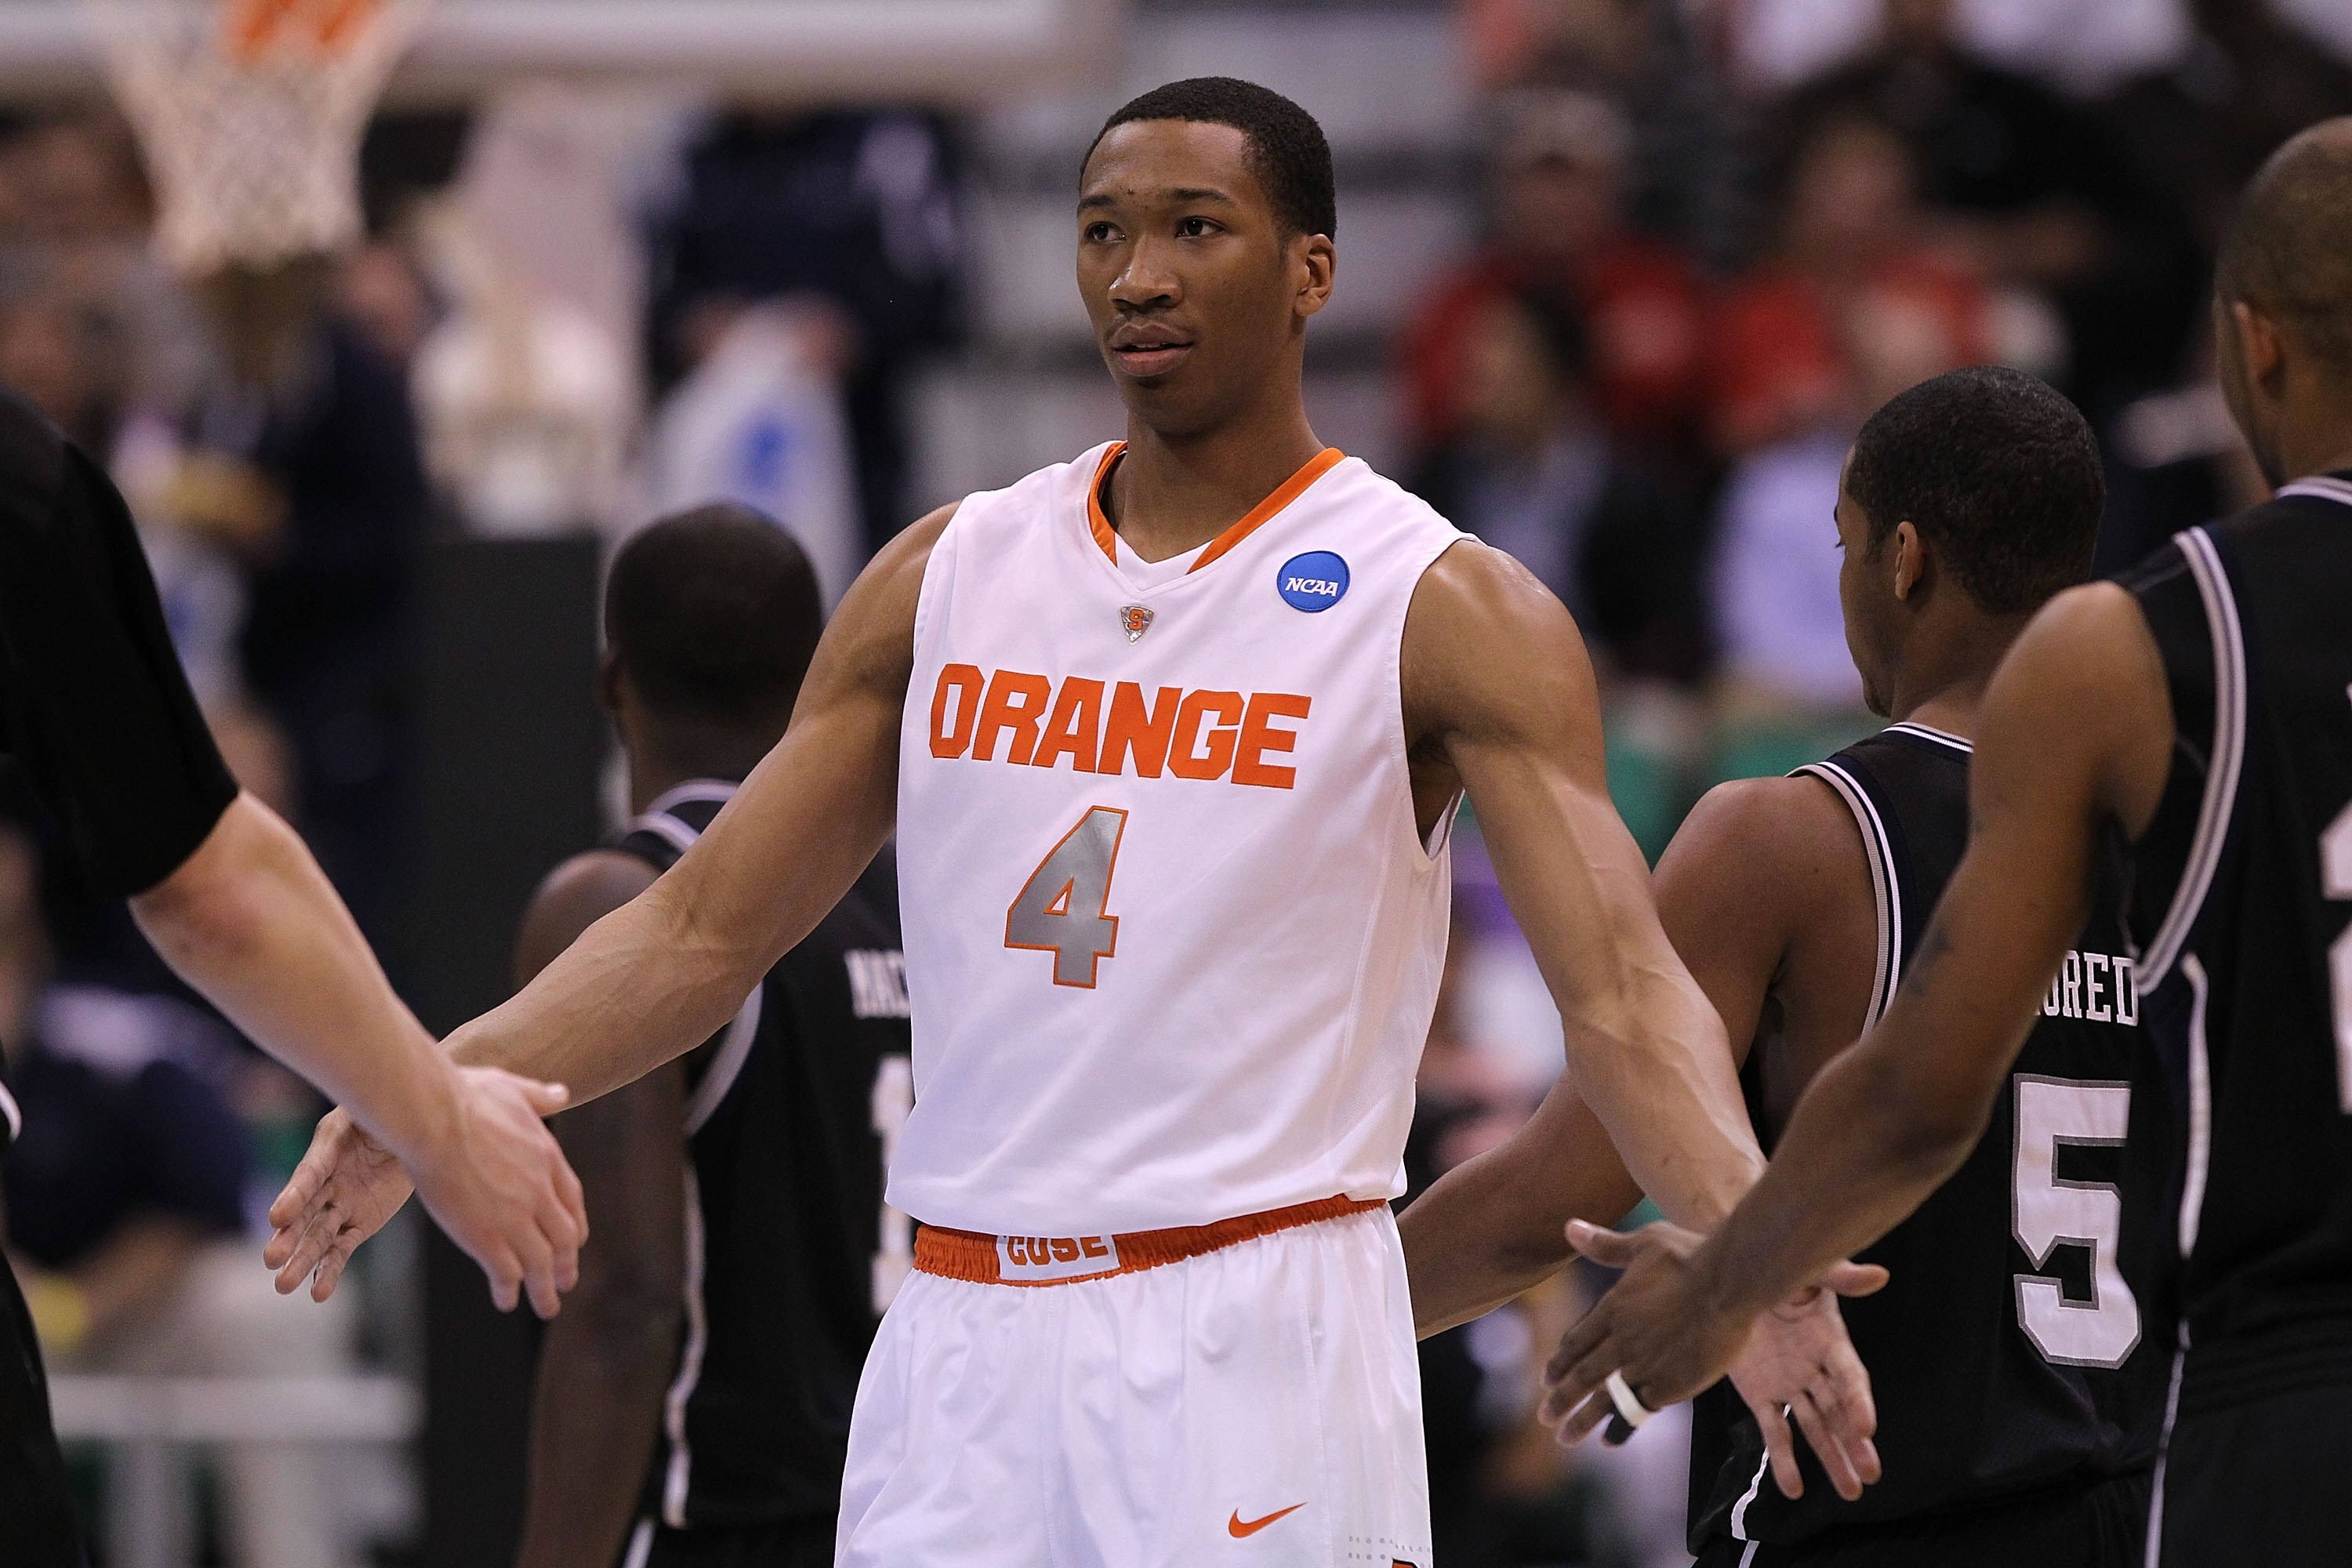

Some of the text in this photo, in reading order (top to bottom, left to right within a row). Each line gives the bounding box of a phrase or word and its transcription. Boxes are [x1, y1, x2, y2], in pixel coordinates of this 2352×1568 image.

[1128, 608, 1144, 630] S
[1284, 576, 1339, 597] NCAA
[929, 663, 1312, 789] ORANGE
[1004, 806, 1128, 989] 4
[2035, 949, 2139, 1026] ORED
[1007, 1236, 1109, 1265] CUSE
[2012, 1073, 2142, 1370] 5
